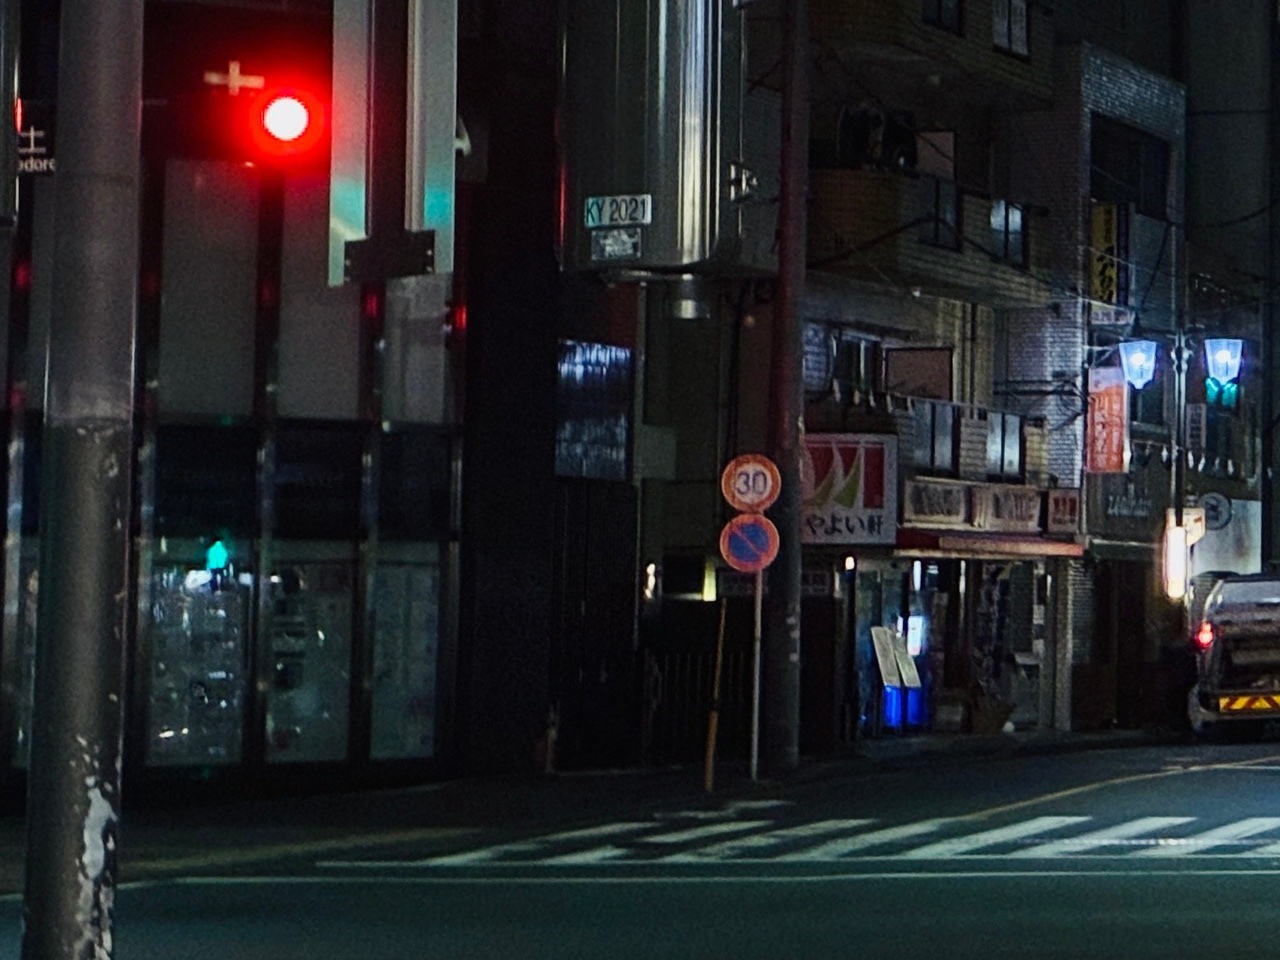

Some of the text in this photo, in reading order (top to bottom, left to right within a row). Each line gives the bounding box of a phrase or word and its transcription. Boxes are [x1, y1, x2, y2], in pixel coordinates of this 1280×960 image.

[586, 197, 646, 223] KY 2021
[735, 471, 768, 495] 30
[805, 513, 884, 536] やよい軒
